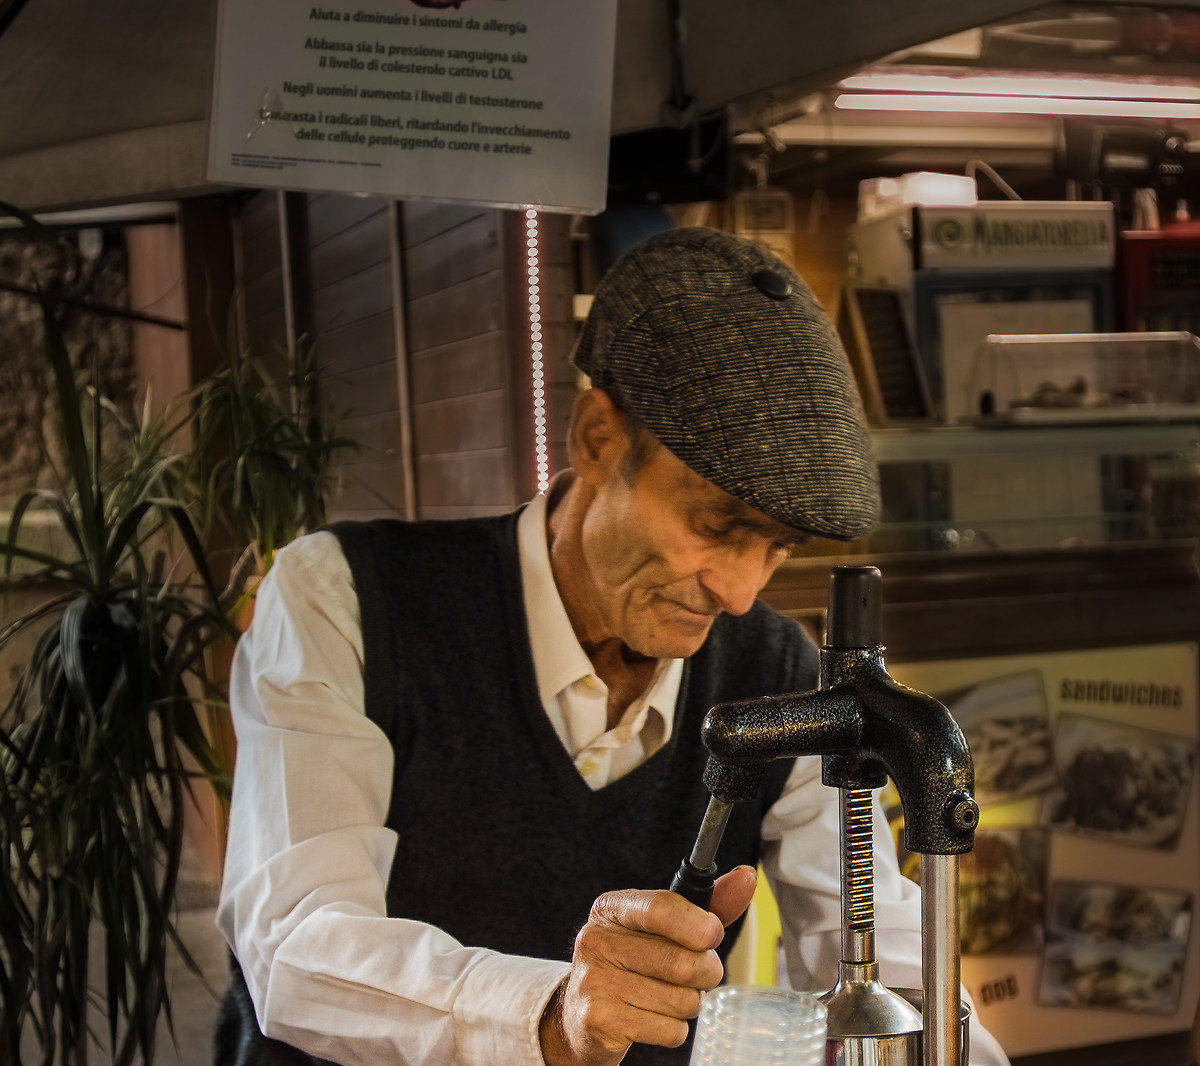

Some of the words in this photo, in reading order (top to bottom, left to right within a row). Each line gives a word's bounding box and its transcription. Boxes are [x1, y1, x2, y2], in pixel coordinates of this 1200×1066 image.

[309, 8, 341, 21] Aiuta
[343, 12, 350, 21] a
[353, 11, 410, 26] diminuire
[419, 15, 462, 28] sintomi
[465, 18, 480, 30] da
[483, 20, 527, 35] allergia
[304, 38, 353, 52] Abbassa
[356, 41, 372, 53] sia
[375, 42, 385, 54] la
[388, 44, 445, 58] pressione
[448, 48, 508, 64] sanguigna
[512, 52, 528, 64] sia
[319, 56, 327, 68] il
[329, 56, 364, 70] livello
[367, 59, 379, 71] di
[381, 60, 446, 75] colesterolo
[448, 66, 489, 78] cattivo
[491, 68, 514, 80] LDL
[283, 82, 314, 97] Negli
[316, 85, 358, 98] uomini
[360, 89, 412, 101] aumenta
[421, 90, 452, 104] livelli
[455, 92, 467, 105] di
[469, 95, 544, 110] testosterone
[325, 112, 367, 126] radicali
[370, 115, 403, 129] liberi,
[406, 118, 469, 133] ritardando
[471, 121, 571, 140] l'invecchiamento
[296, 128, 325, 141] delle
[328, 130, 366, 144] cellule
[368, 135, 445, 150] proteggendo
[448, 140, 480, 152] cuore
[492, 142, 532, 155] arterie
[1059, 678, 1184, 709] sandwiches
